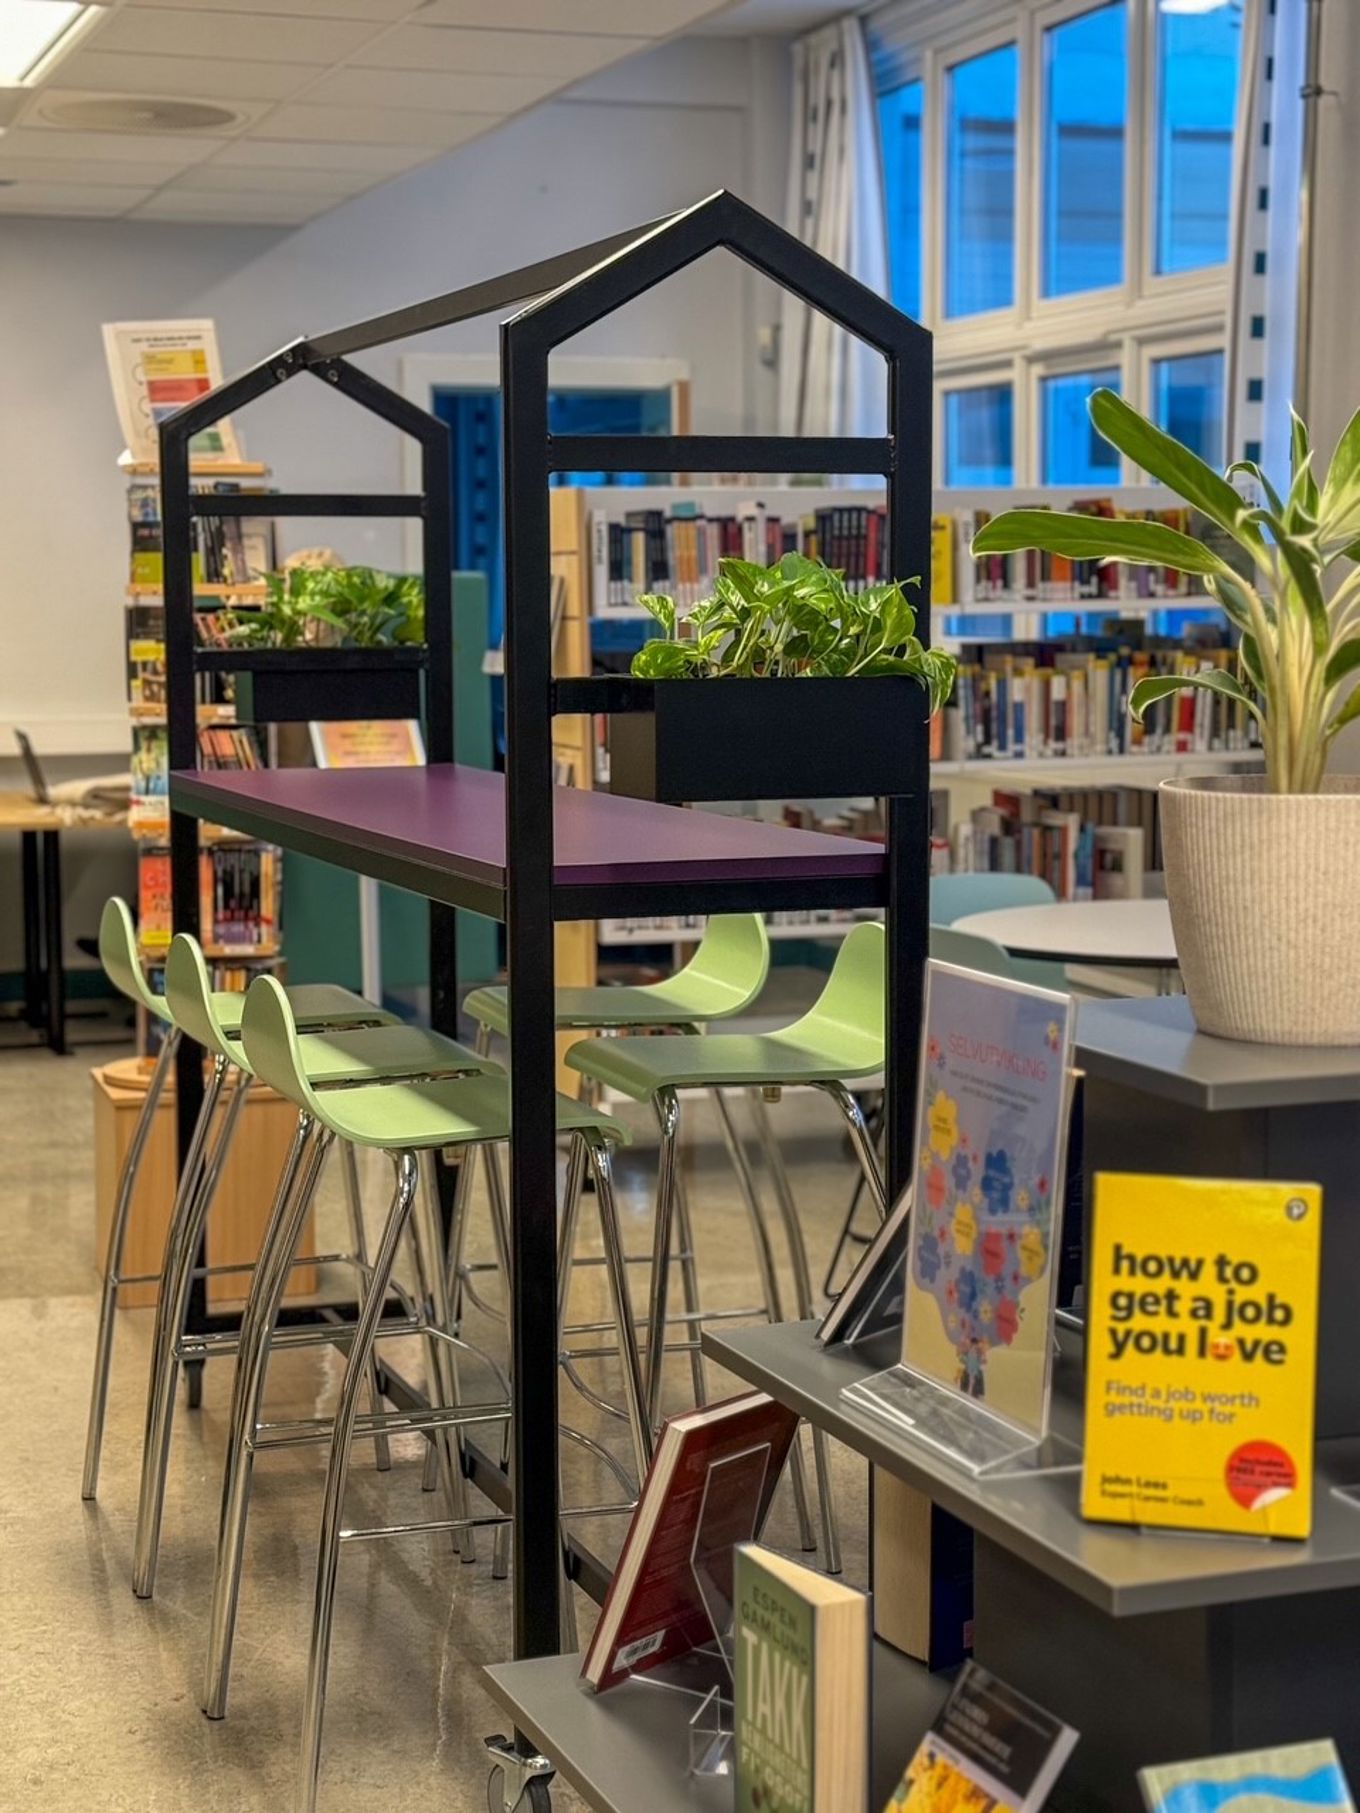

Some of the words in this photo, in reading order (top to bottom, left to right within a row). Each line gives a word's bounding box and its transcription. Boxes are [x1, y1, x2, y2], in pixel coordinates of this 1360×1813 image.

[1112, 1243, 1204, 1282] how
[1214, 1253, 1259, 1286] to
[1108, 1288, 1181, 1322] get
[1189, 1296, 1213, 1321] a
[1220, 1288, 1293, 1331] job
[1107, 1327, 1186, 1360] you
[1105, 1380, 1146, 1398] Find
[1151, 1387, 1162, 1400] a
[1165, 1384, 1196, 1403] job
[1201, 1392, 1260, 1408] worth
[1104, 1401, 1174, 1422] getting
[1179, 1410, 1204, 1424] up
[1209, 1407, 1237, 1424] for
[1101, 1474, 1133, 1487] John
[1101, 1488, 1134, 1501] Expert
[752, 1585, 798, 1631] ESPEN
[741, 1625, 809, 1771] TAKK
